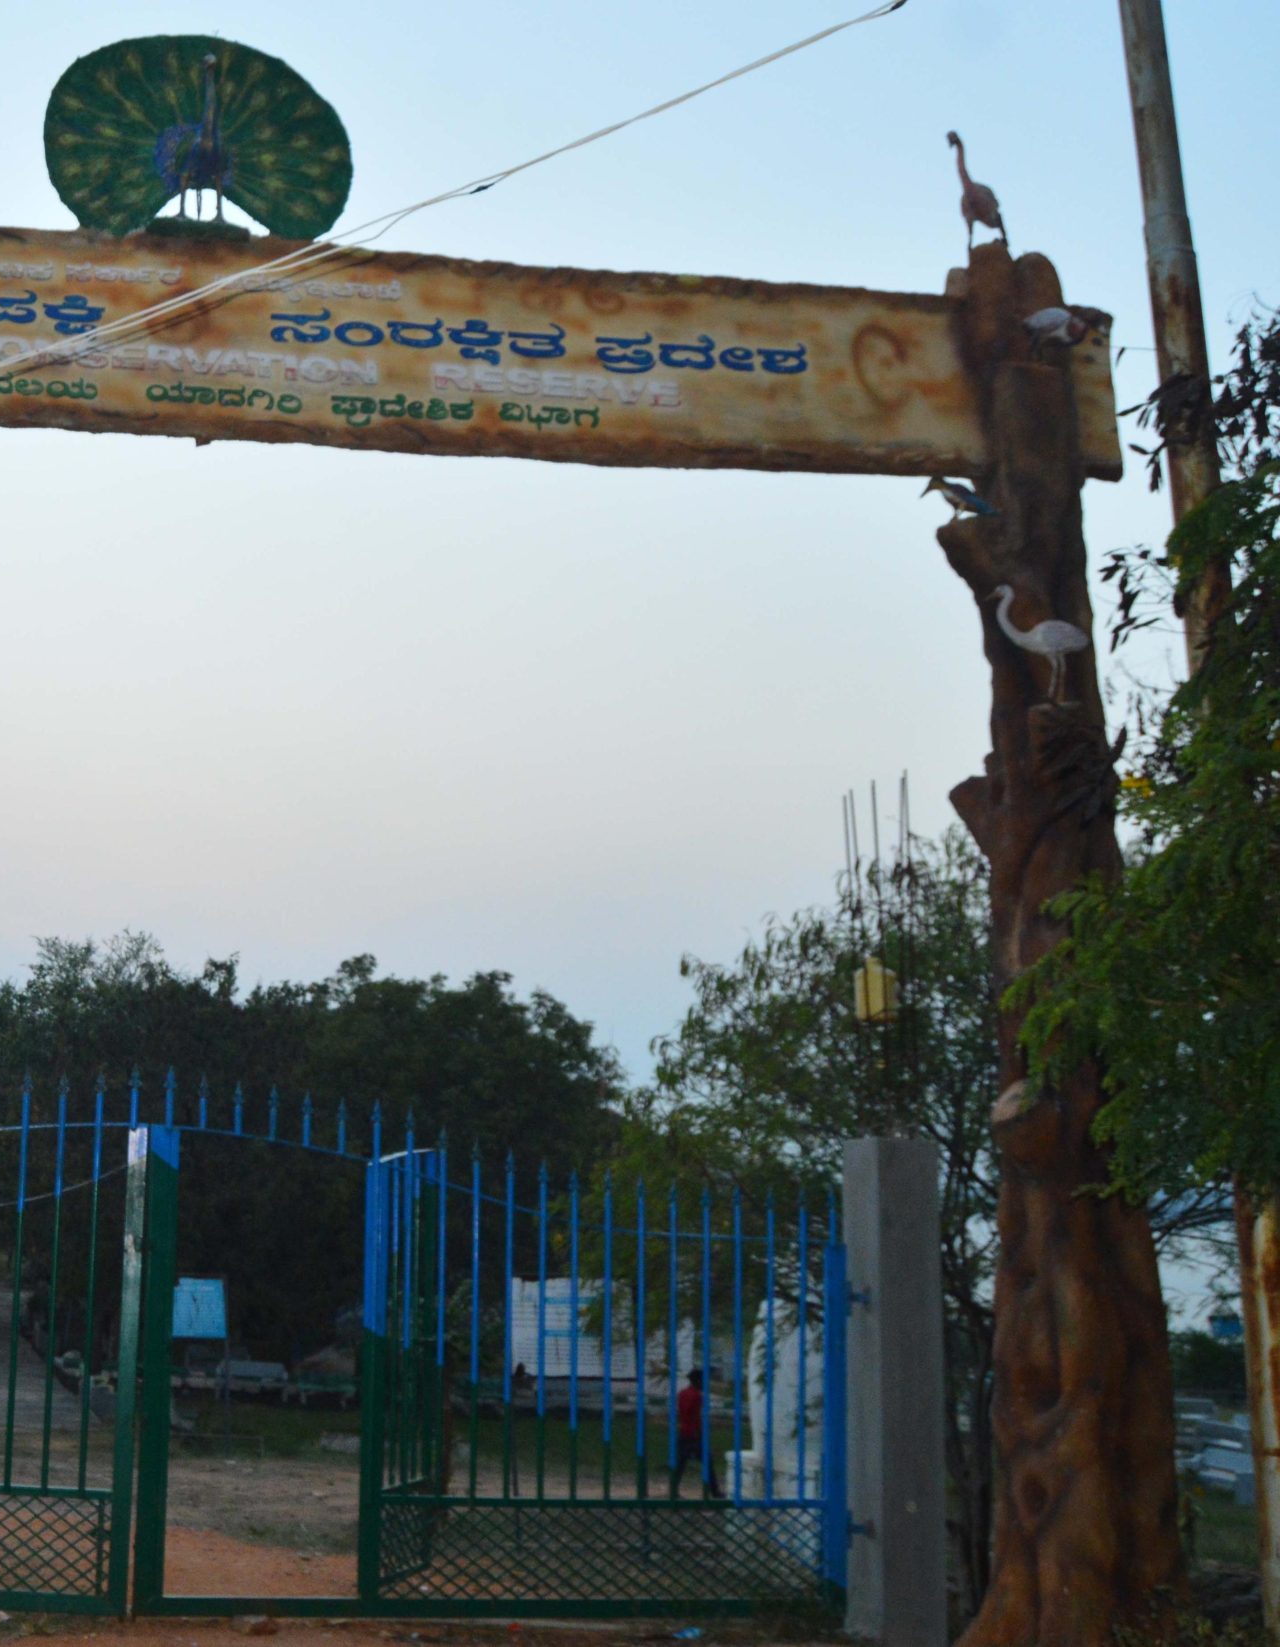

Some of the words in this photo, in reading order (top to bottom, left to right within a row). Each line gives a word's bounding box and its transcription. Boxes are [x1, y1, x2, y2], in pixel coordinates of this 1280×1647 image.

[270, 308, 567, 366] ಸಂರಕ್ಷಿತ
[595, 332, 809, 374] ಪ್ರದೇಶ
[146, 381, 303, 414] ಯಾದಗಿರಿ
[331, 394, 474, 427] ಪ್ರಾದೇಶಿಕ
[498, 402, 601, 430] ವಿಭಾಗ
[432, 363, 682, 408] RESERVE
